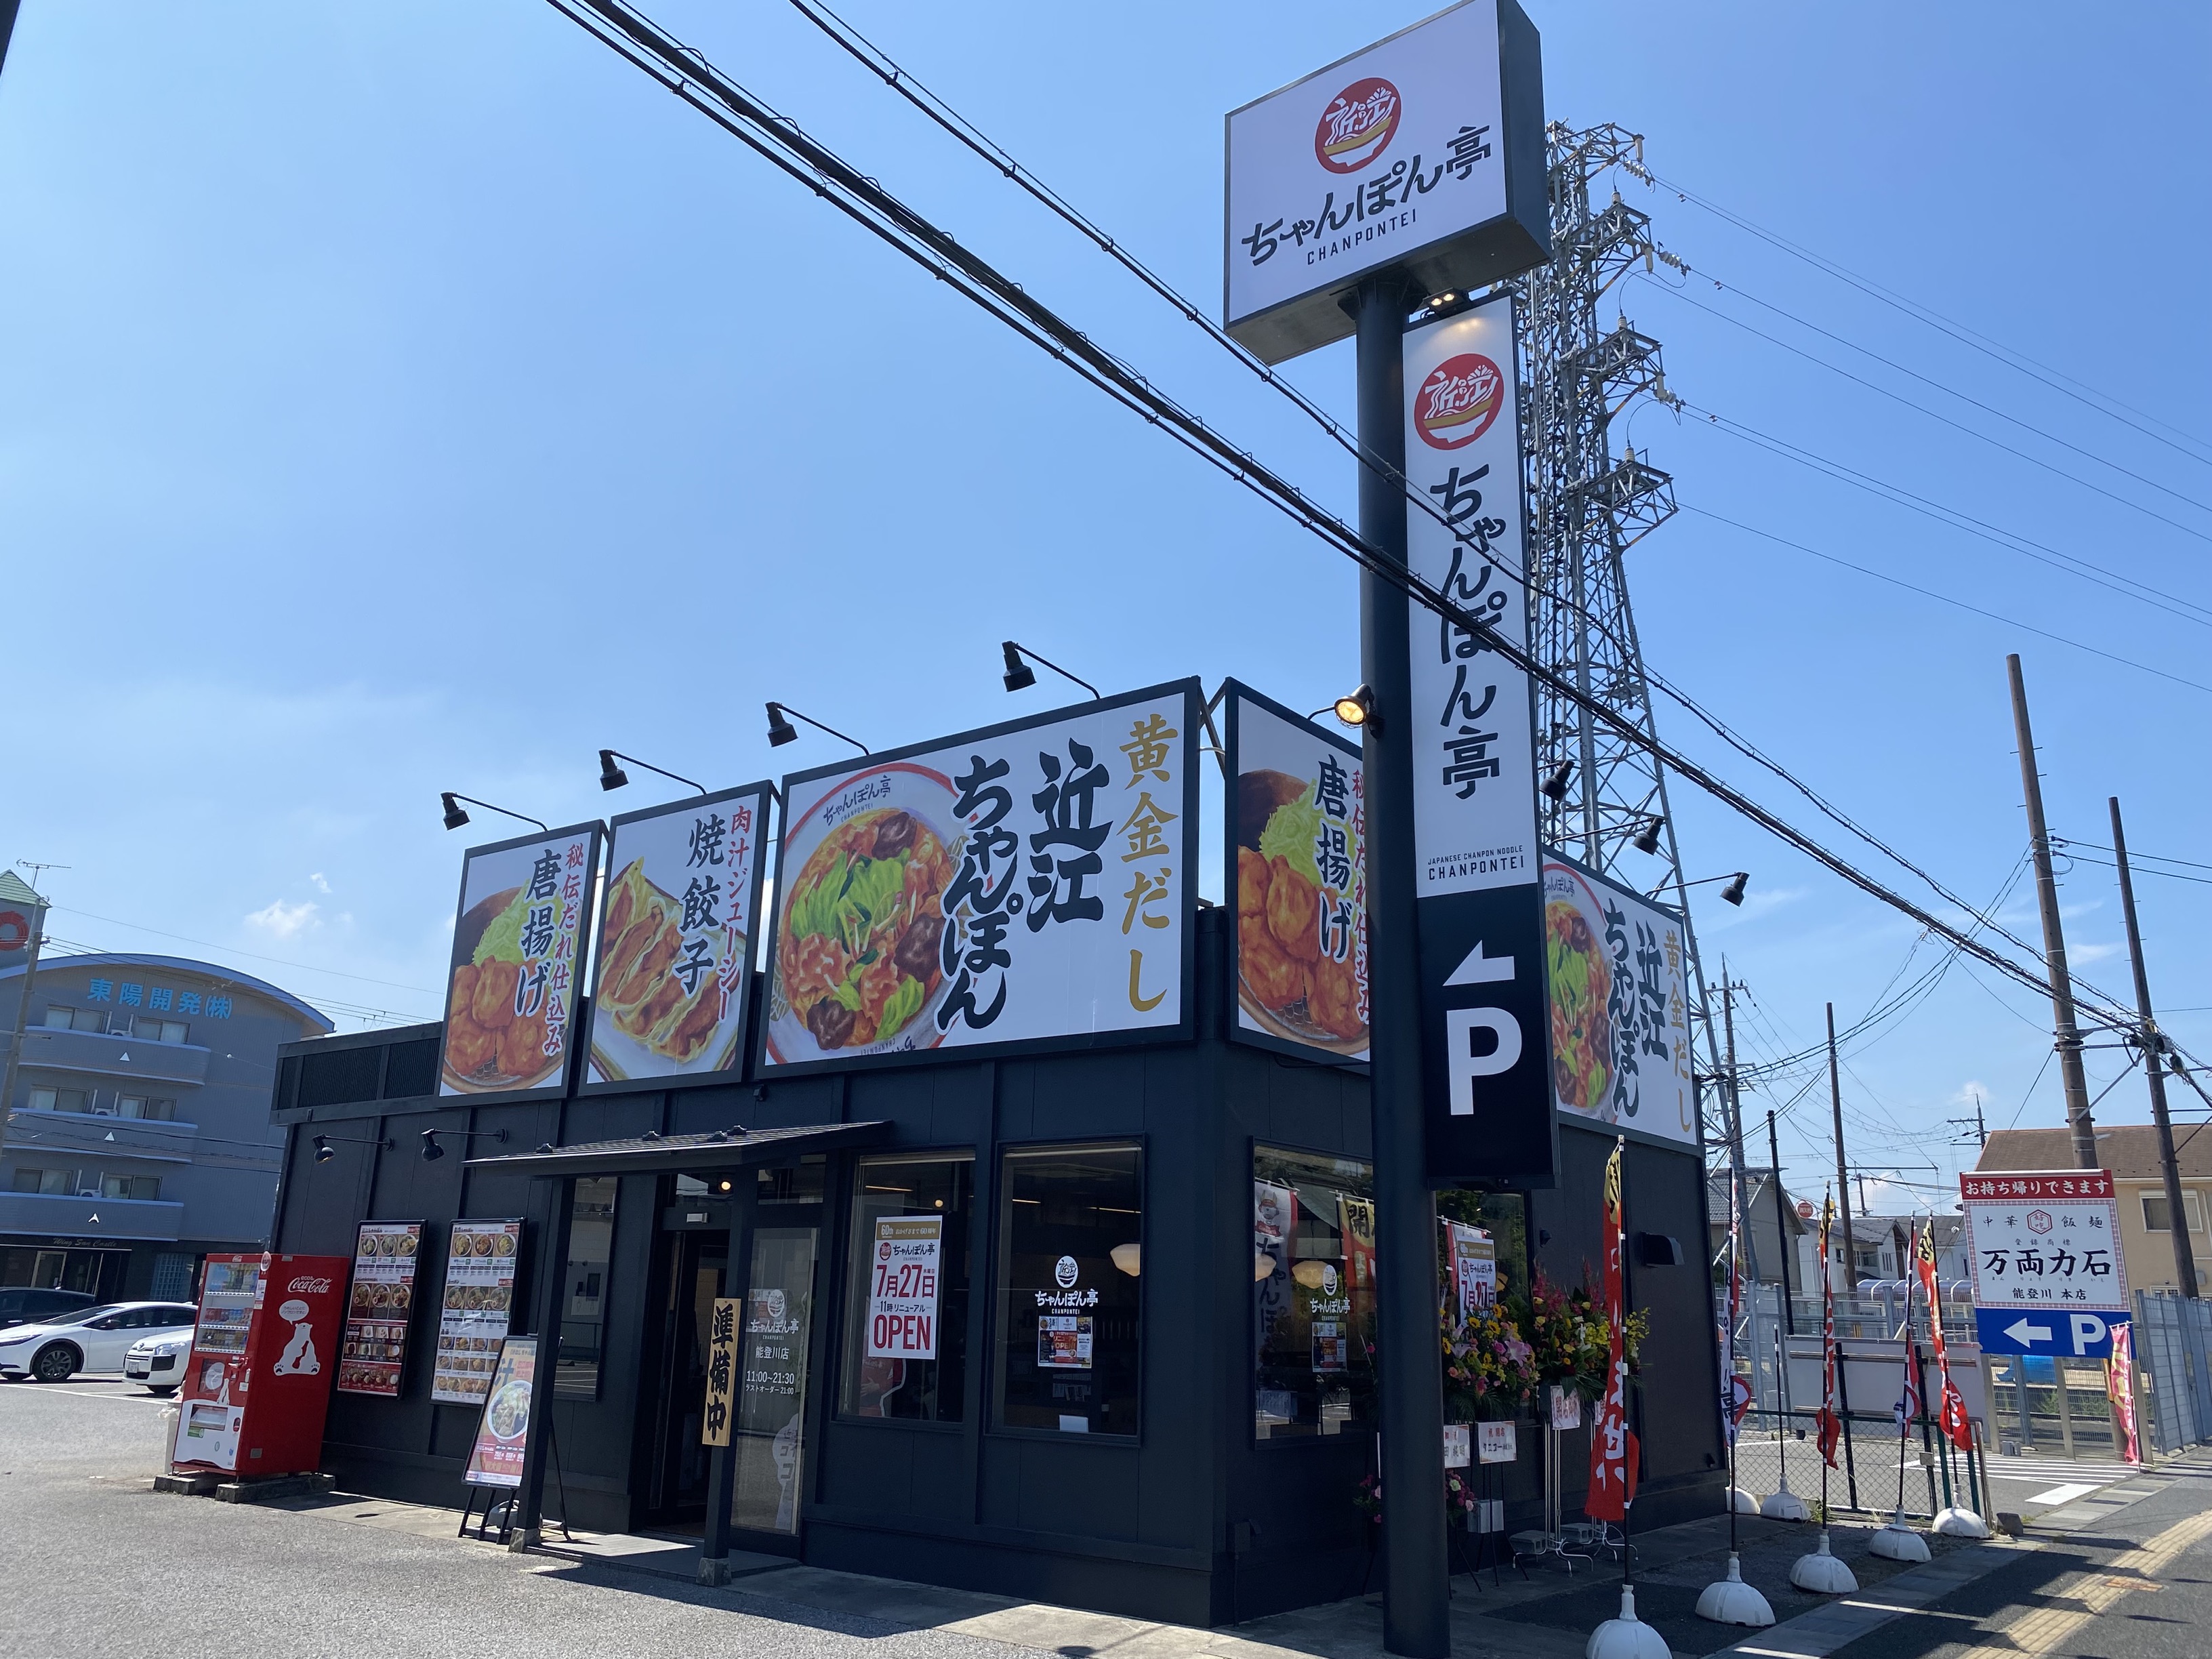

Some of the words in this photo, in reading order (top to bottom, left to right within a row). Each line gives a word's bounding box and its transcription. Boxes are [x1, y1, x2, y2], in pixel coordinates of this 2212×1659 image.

[1242, 125, 1491, 266] ちゃんぽん亭
[1308, 209, 1417, 265] CHANPONTEI
[1430, 464, 1508, 800] ちゃんぽん亭
[823, 775, 891, 826] ちゃんぽん亭
[841, 803, 873, 823] CHANPONTEI
[1026, 738, 1113, 933] 近江
[1316, 754, 1352, 960] 唐揚げ
[1428, 854, 1461, 865] JAPANESE
[1464, 849, 1494, 860] CHANPON
[1497, 845, 1523, 855] NOODLE
[1116, 714, 1179, 1012] 黄金だし
[1429, 855, 1524, 880] CHANPONTEI
[675, 814, 726, 996] 焼餃子
[718, 805, 752, 1021] 肉汁ジューシー
[937, 755, 1023, 1031] ちゃんぽん
[517, 849, 562, 1014] 唐揚げ
[544, 843, 584, 1055] 秘伝だれ仕込み
[1604, 898, 1639, 1118] ちゃんぽん
[1637, 920, 1668, 1061] 近江
[1664, 929, 1692, 1132] 黄金だし
[1447, 1007, 1522, 1115] P
[1965, 1180, 2109, 1195] お持ち帰りできます
[881, 1225, 894, 1235] 60th
[893, 1242, 935, 1256] ちゃんぽん亭
[876, 1264, 935, 1298] 7月27日
[1469, 1263, 1493, 1275] ちゃんぽん亭
[1981, 1248, 2111, 1276] 万両力石
[1035, 1288, 1098, 1307] ちゃんぽん亭
[1310, 1297, 1351, 1314] ちゃんぽん亭
[2012, 1288, 2052, 1299] 能登川
[2061, 1288, 2087, 1300] 本店
[750, 1318, 799, 1334] ちゃんぽん亭
[874, 1315, 930, 1351] OPEN
[2070, 1314, 2106, 1355] P
[708, 1303, 733, 1441] 準備中
[756, 1346, 790, 1359] 能登川店
[745, 1384, 779, 1393] ラストオーダー
[780, 1387, 794, 1395] 21:00
